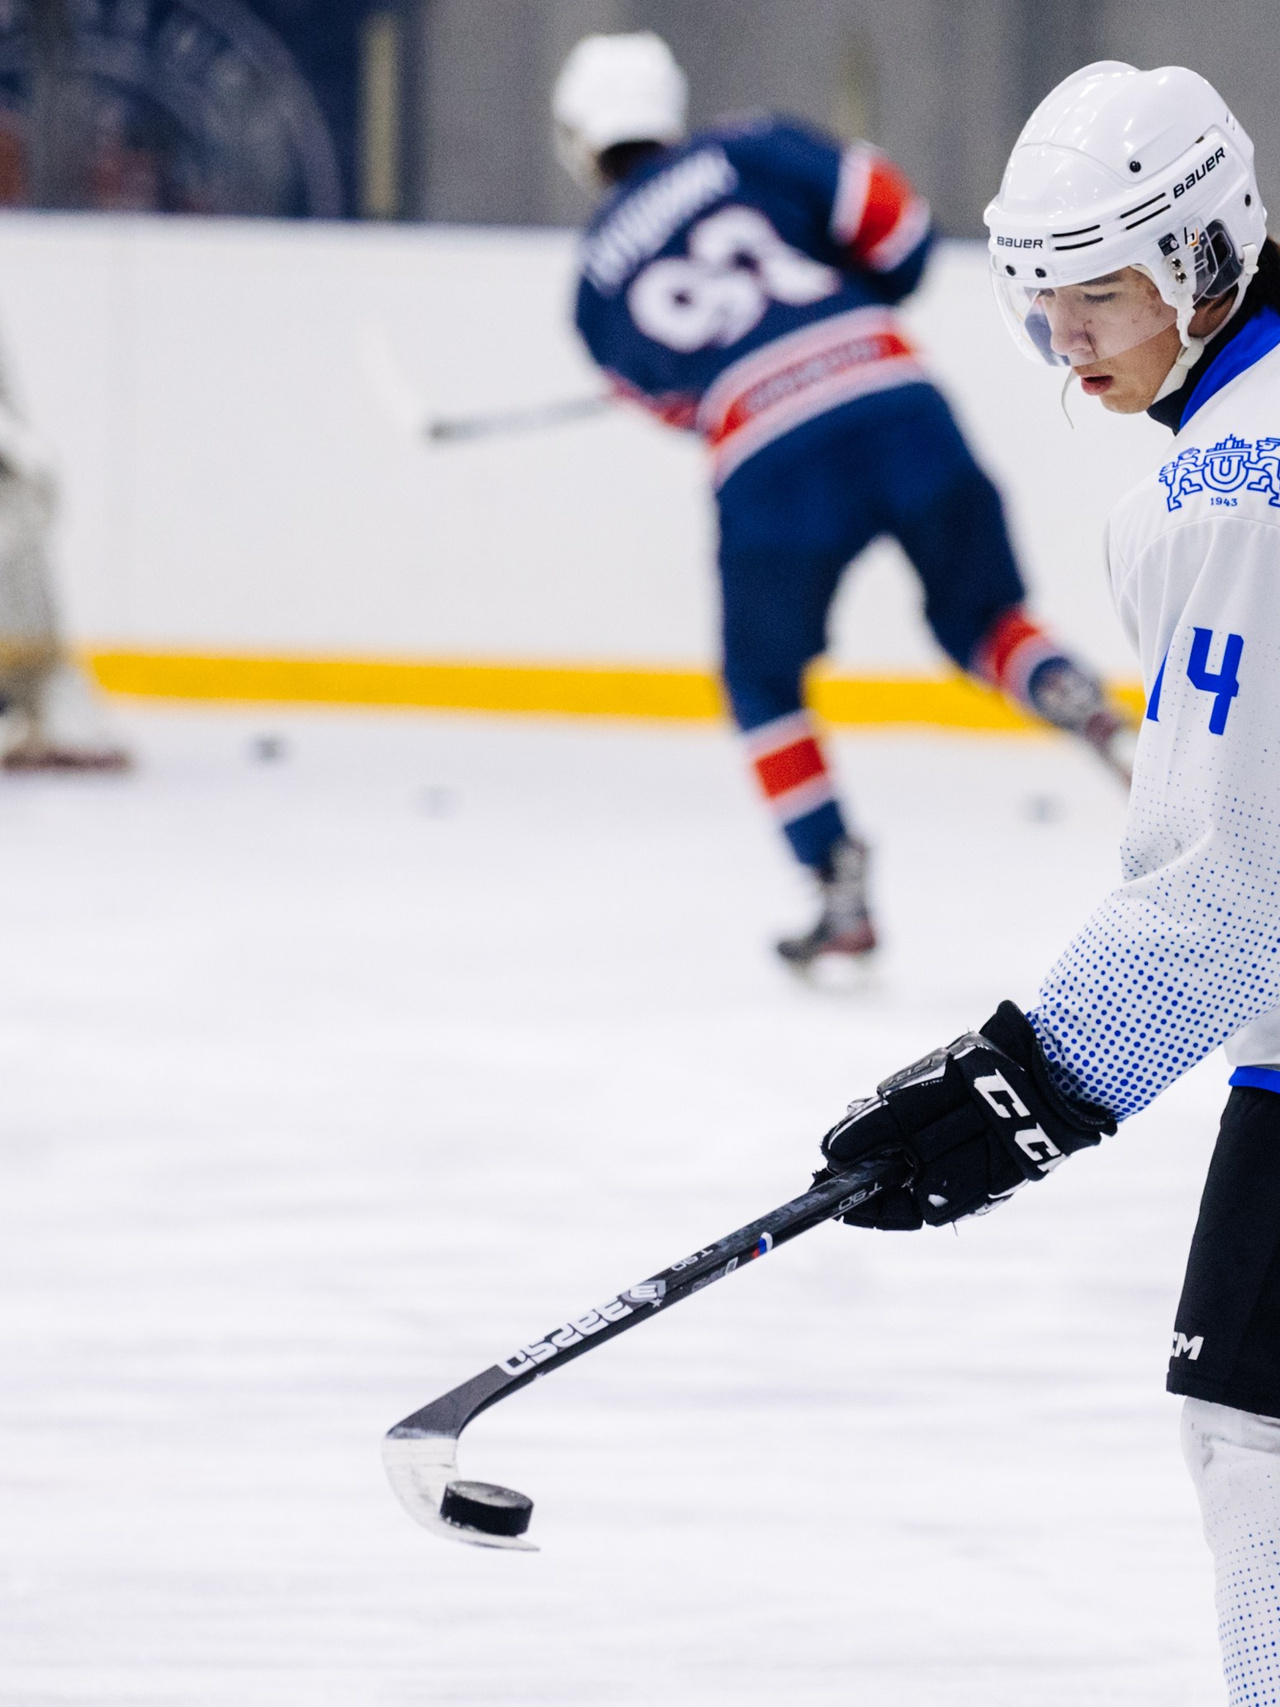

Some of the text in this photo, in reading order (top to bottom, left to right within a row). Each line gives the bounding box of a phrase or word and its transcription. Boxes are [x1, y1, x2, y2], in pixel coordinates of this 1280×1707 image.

[1173, 147, 1226, 199] BAUER
[996, 235, 1044, 250] BAUER
[1210, 497, 1238, 507] 1943
[974, 1068, 1070, 1173] CC
